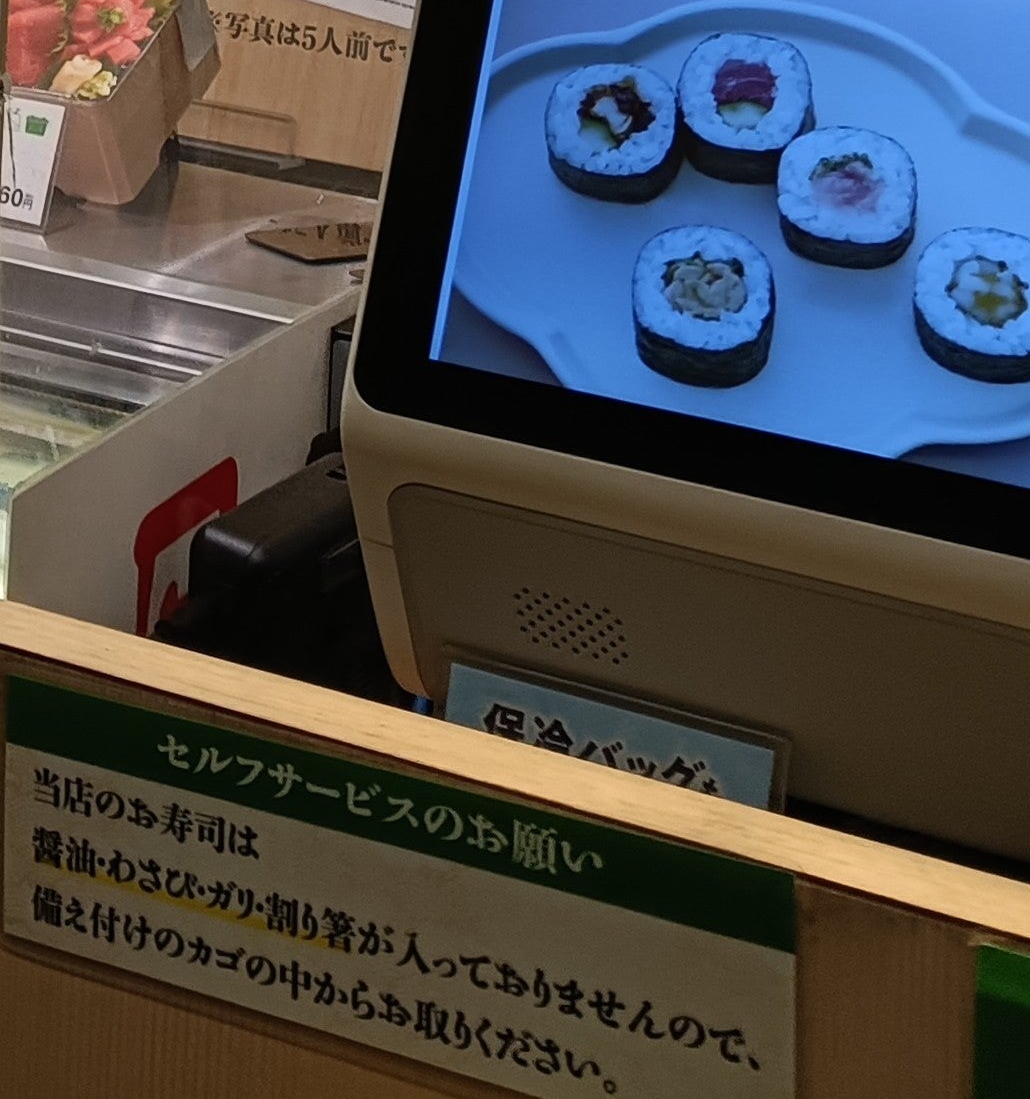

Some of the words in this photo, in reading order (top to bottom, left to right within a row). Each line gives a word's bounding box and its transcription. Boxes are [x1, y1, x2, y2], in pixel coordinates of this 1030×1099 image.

[33, 767, 260, 860] 当店のお寿司は
[156, 733, 605, 875] セルフサービスのお願い
[30, 884, 618, 1096] 備え付けのカゴの中からお取りください。
